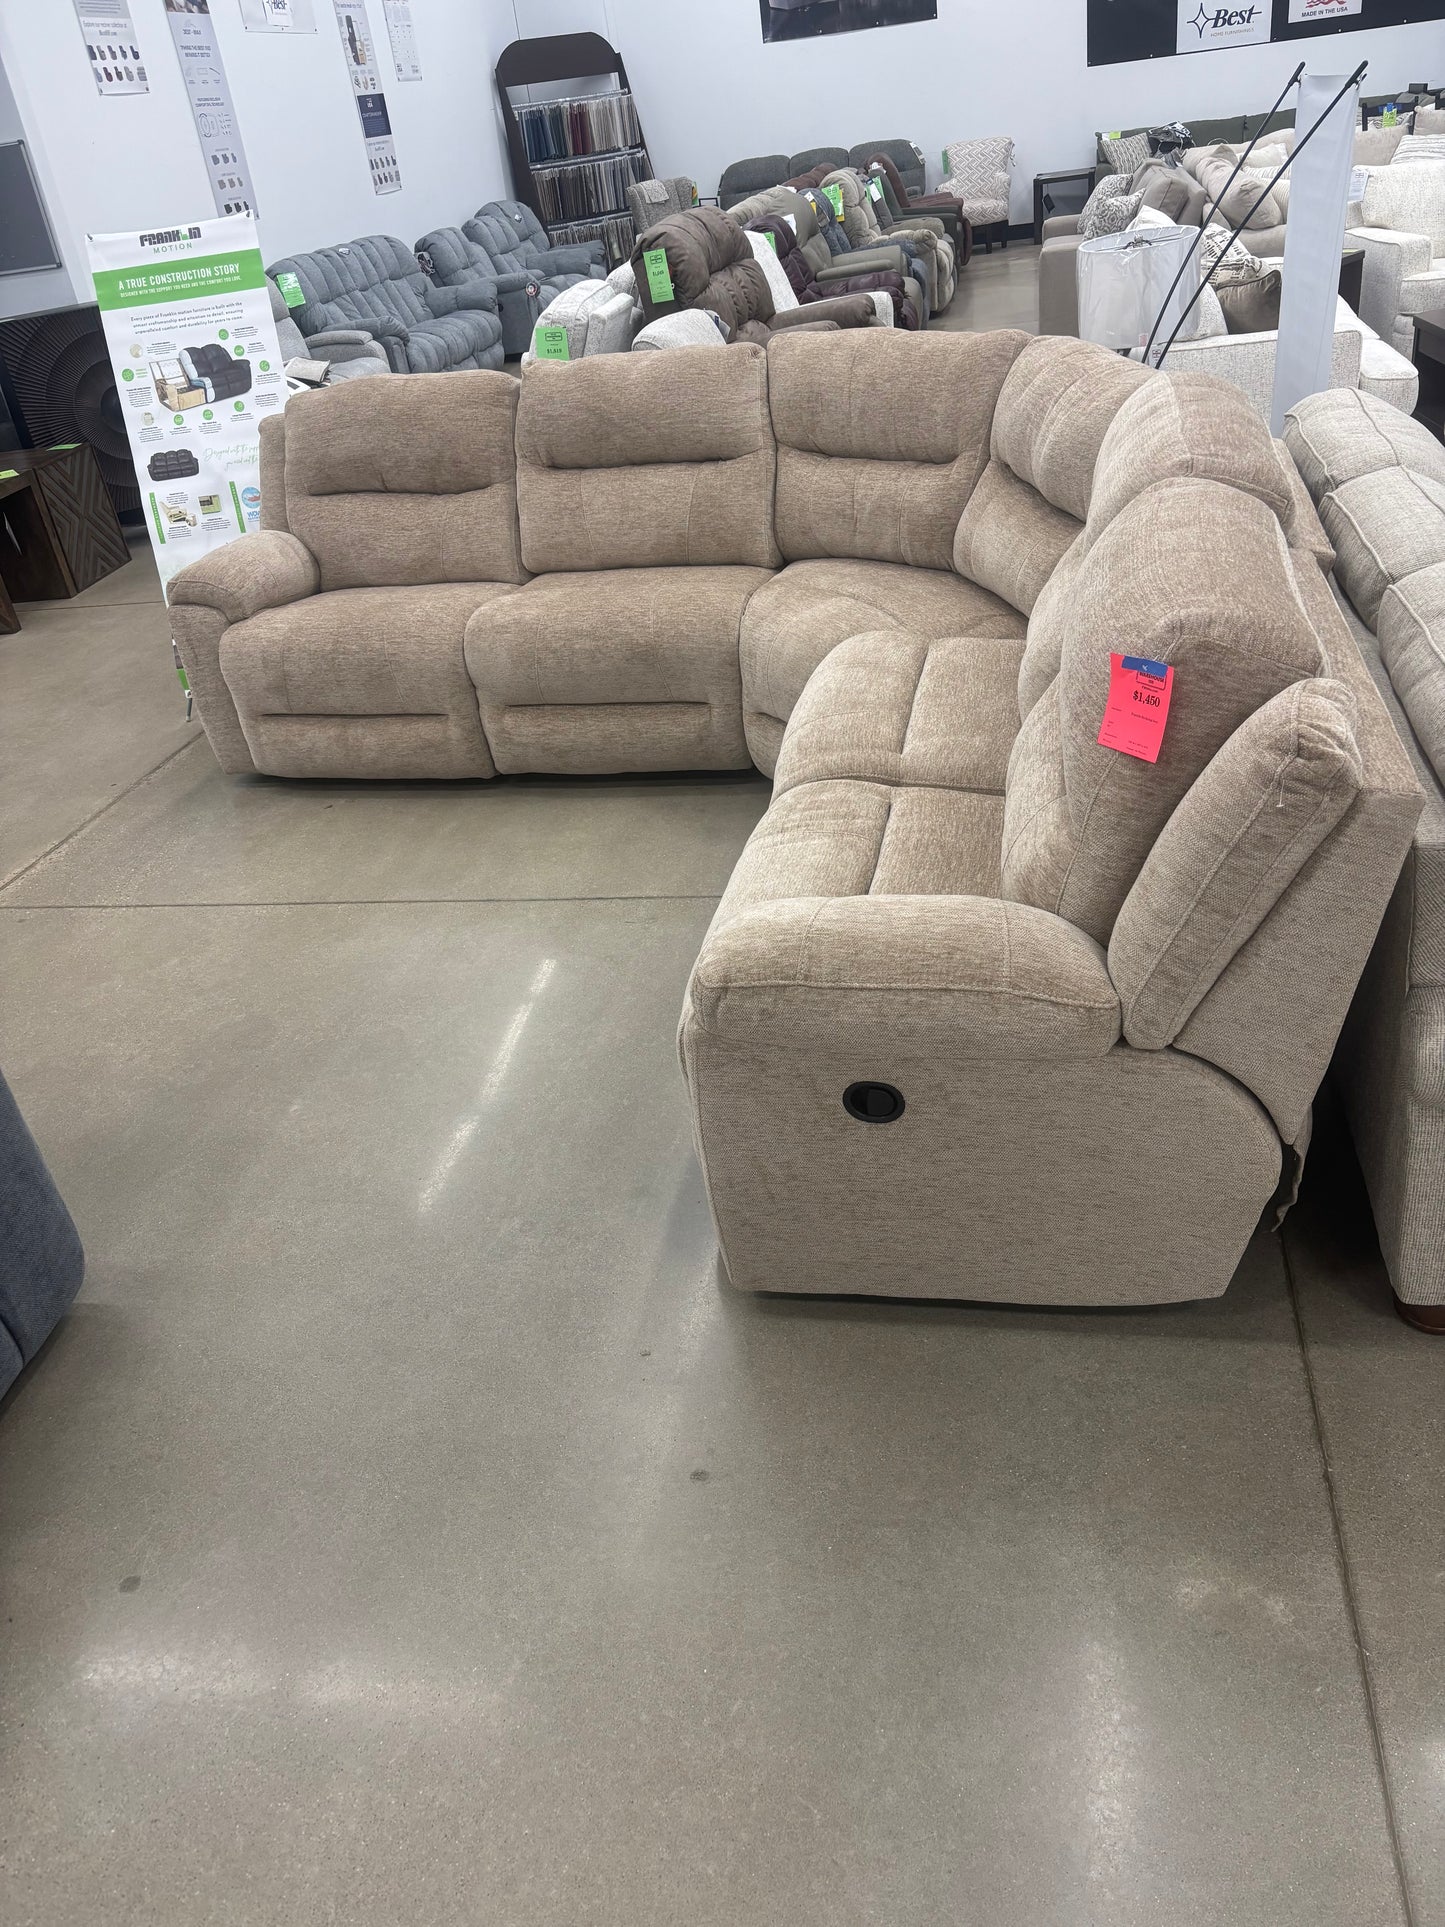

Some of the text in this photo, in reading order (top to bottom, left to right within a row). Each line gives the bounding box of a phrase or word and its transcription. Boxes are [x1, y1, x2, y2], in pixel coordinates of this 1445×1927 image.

[1211, 5, 1262, 28] Best
[139, 227, 201, 247] FRANKLIN
[153, 242, 192, 254] MOTION
[119, 263, 240, 290] A TRUE CONSTRUCTION STORY
[1133, 690, 1160, 708] $1,450
